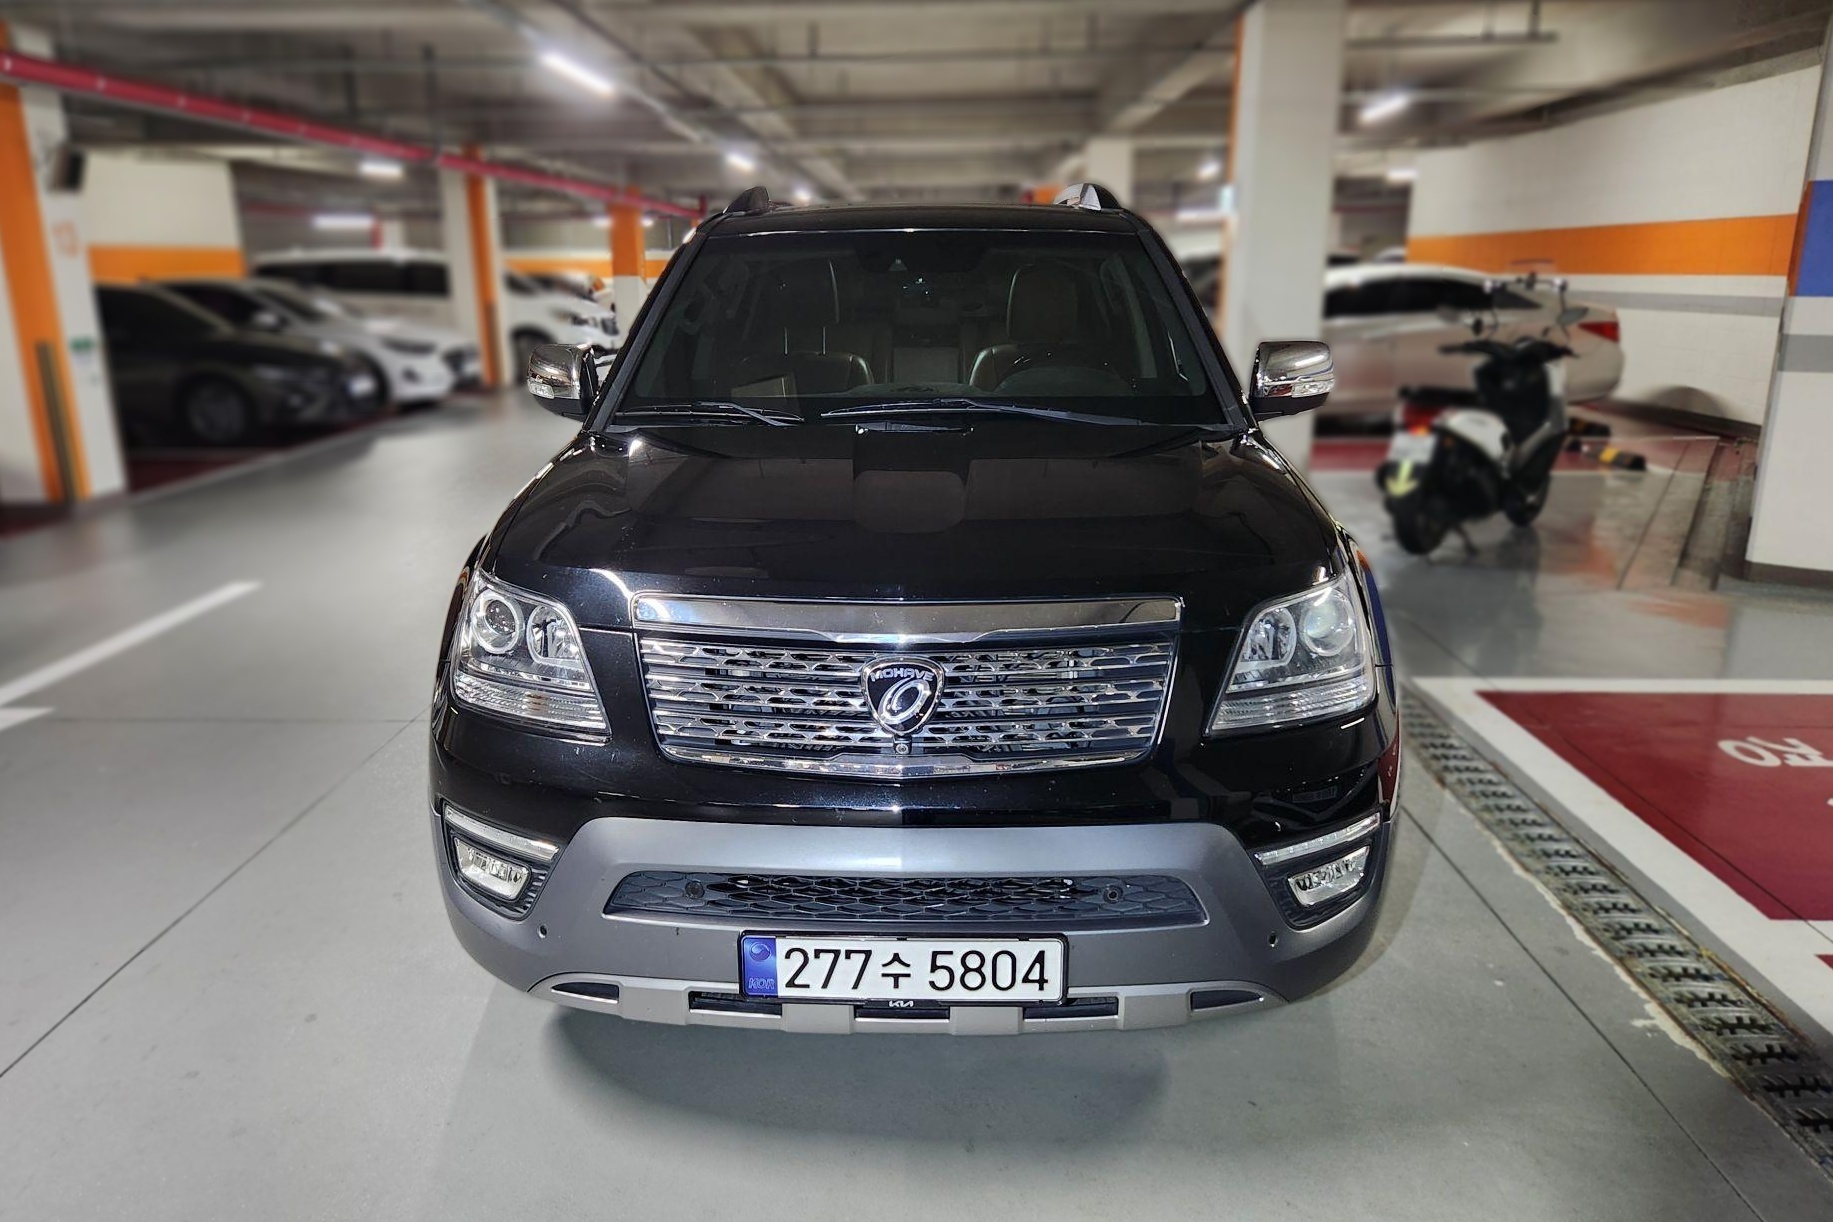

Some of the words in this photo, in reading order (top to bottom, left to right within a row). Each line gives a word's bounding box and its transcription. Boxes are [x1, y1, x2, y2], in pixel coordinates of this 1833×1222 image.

[870, 668, 934, 682] MOHAVE
[784, 947, 912, 990] 277수
[929, 949, 1049, 991] 5804
[748, 977, 775, 990] KOR
